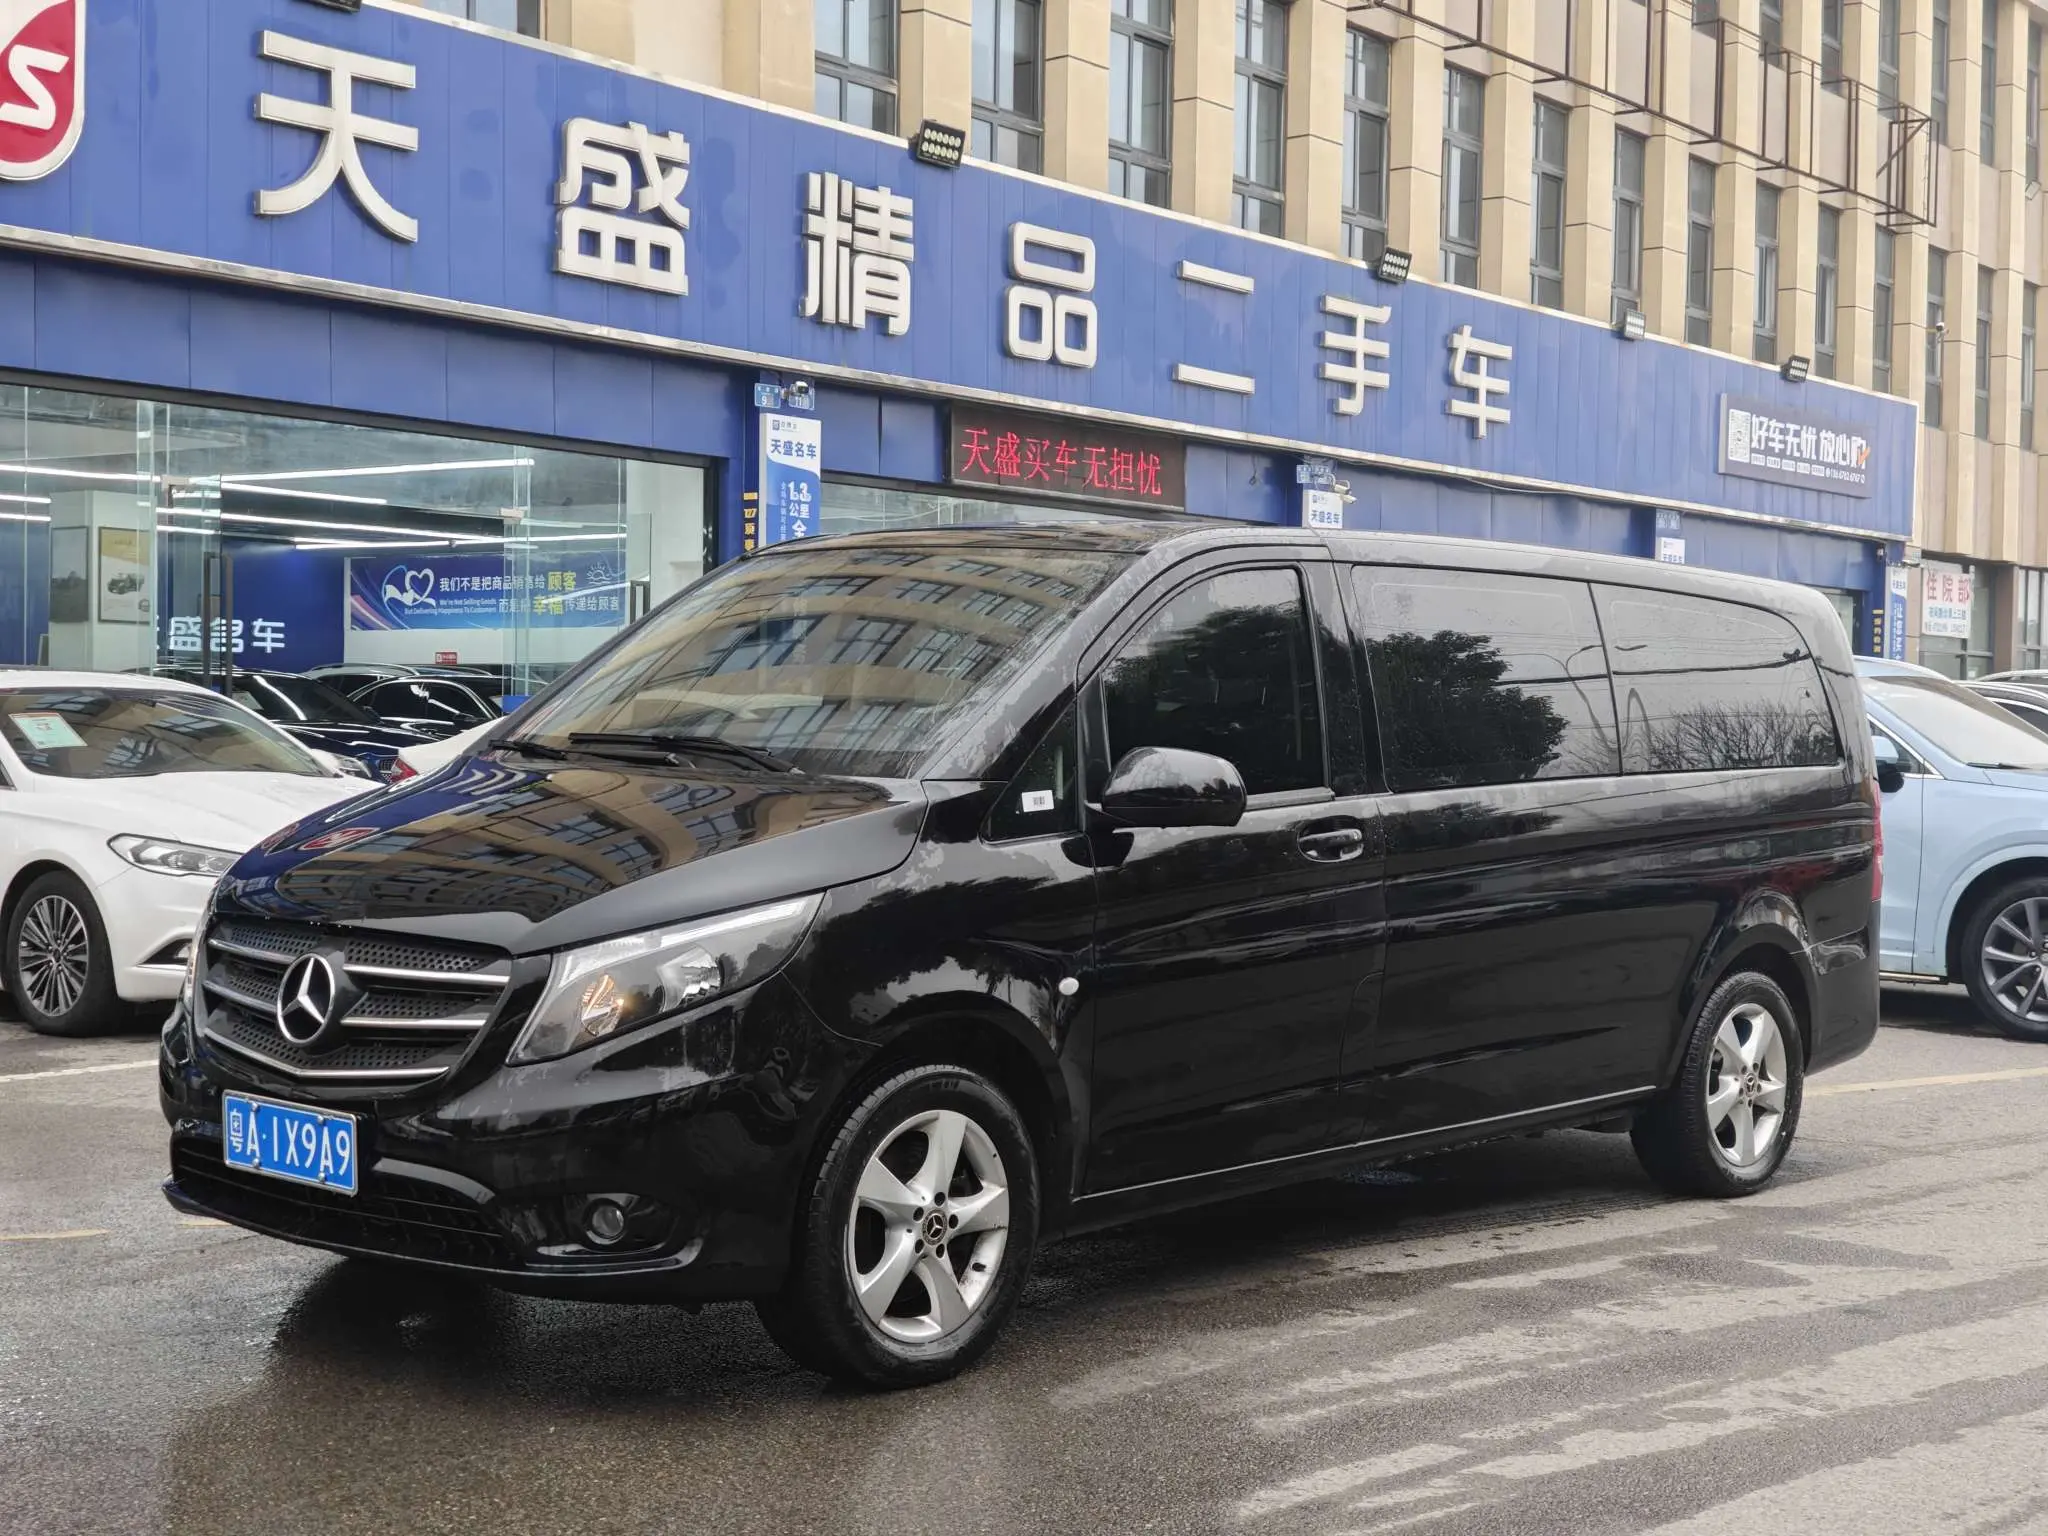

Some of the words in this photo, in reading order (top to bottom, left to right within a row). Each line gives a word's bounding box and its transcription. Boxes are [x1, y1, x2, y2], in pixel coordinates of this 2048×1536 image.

[254, 29, 1513, 438] 天盛精品二手车
[771, 438, 817, 459] 天盛名车
[1751, 414, 1817, 460] 好车无忧
[961, 427, 1162, 496] 天盛买车无担忧
[1927, 571, 1970, 603] 住院部
[156, 615, 285, 654] 盛名车
